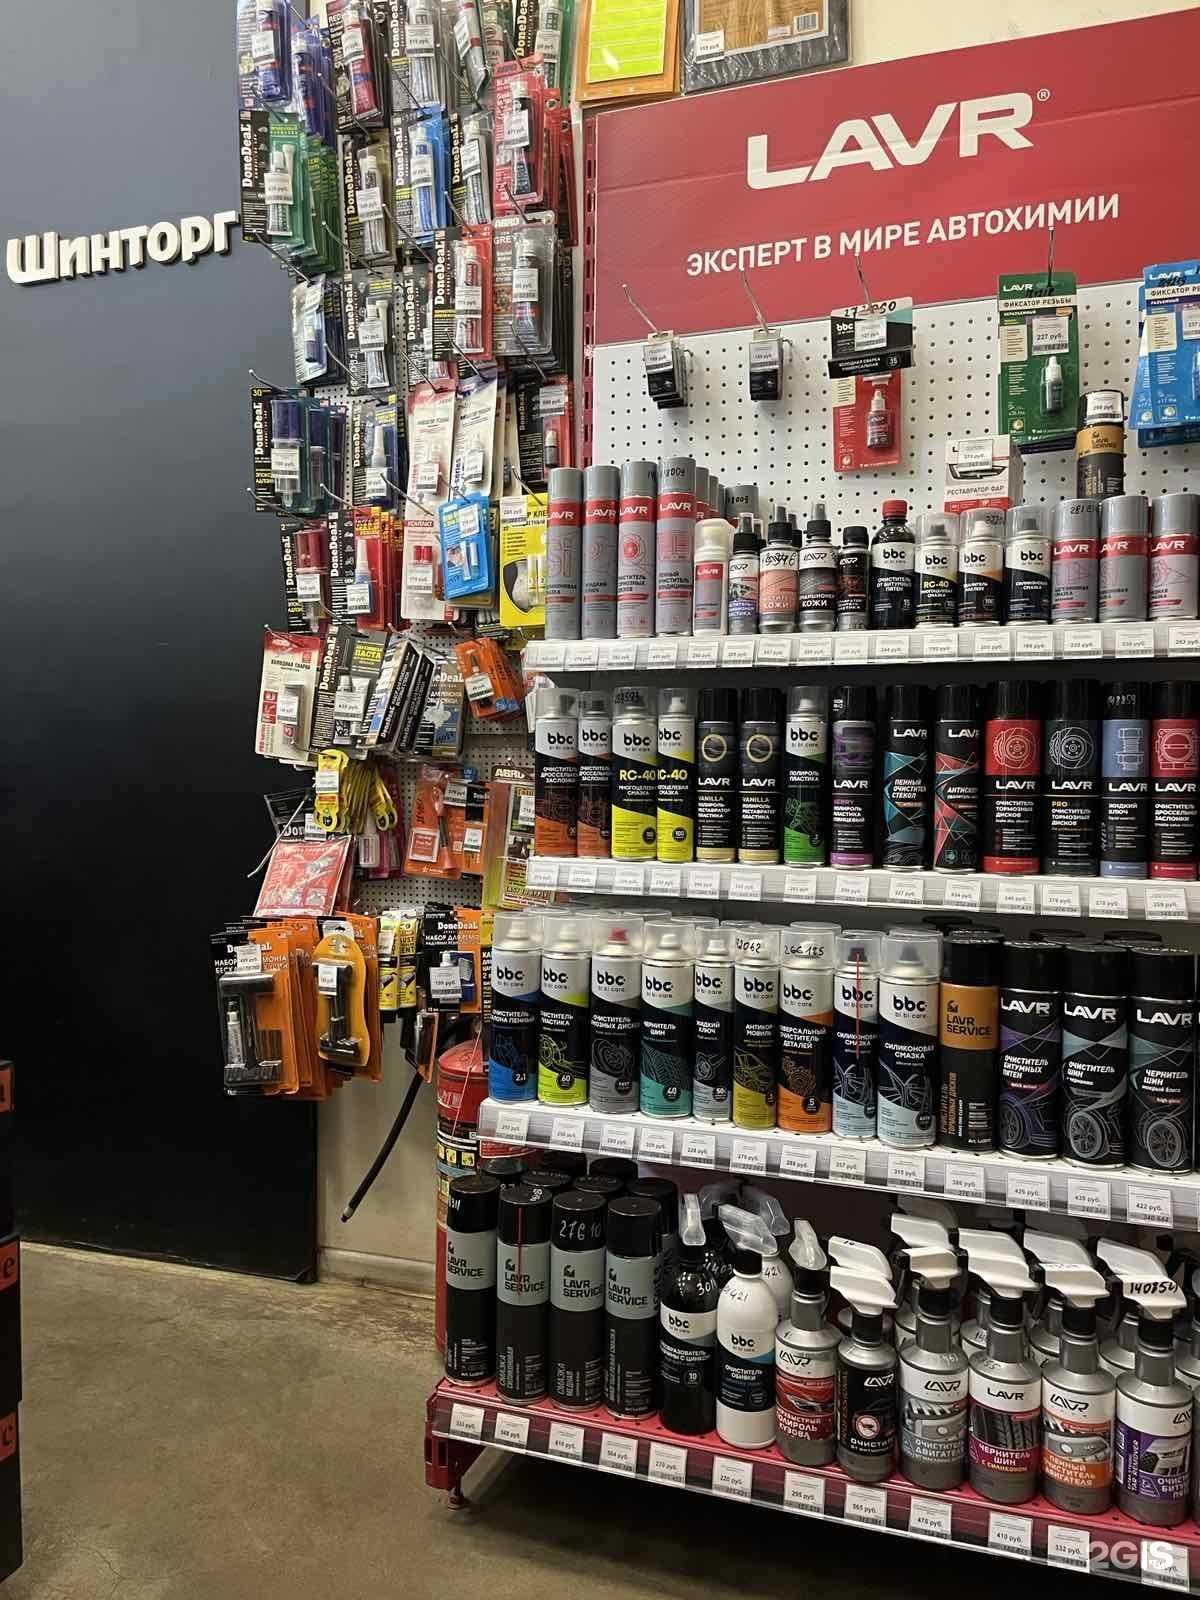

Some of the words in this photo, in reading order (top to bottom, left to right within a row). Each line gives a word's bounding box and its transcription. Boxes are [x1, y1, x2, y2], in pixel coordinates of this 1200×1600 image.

[747, 92, 1033, 190] LAVR
[687, 238, 806, 277] ЭКСПЕРТ
[814, 233, 832, 258] В
[839, 221, 920, 256] МИРЕ
[927, 194, 1120, 241] АВТОХИМИИ
[1150, 271, 1182, 280] LAVR
[1002, 284, 1033, 292] LAVR
[1150, 287, 1190, 296] ФИКСАТОР
[1003, 300, 1041, 308] ФИКСАТОР
[1042, 298, 1072, 306] РЕЗЬБЫ
[660, 502, 691, 511] LAVR
[586, 508, 616, 517] LAVR
[882, 548, 905, 558] bbc
[1054, 543, 1089, 554] LAVR
[925, 554, 947, 565] bbc
[963, 553, 985, 564] bbc
[1020, 551, 1043, 561] bbc
[802, 599, 828, 607] КОЖИ
[582, 729, 608, 741] bbc
[790, 728, 818, 741] bbc
[893, 729, 927, 737] LAVR
[548, 733, 573, 745] bbc
[624, 733, 650, 746] bbc
[619, 769, 655, 781] RC-40
[698, 777, 731, 786] LAVR
[742, 778, 776, 787] LAVR
[833, 780, 869, 788] LAVR
[996, 780, 1036, 790] LAVR
[1051, 781, 1092, 790] LAVR
[1108, 782, 1148, 792] LAVR
[1155, 783, 1197, 792] LAVR
[496, 966, 524, 981] bbc
[543, 967, 568, 983] bbc
[596, 970, 625, 986] bbc
[645, 976, 674, 992] bbc
[695, 973, 721, 988] bbc
[744, 977, 774, 993] bbc
[783, 984, 813, 1000] bbc
[841, 985, 874, 1001] bbc
[893, 994, 927, 1012] bbc
[1000, 997, 1050, 1014] LAVR
[1064, 1001, 1117, 1020] LAVR
[946, 1014, 976, 1026] LAVR
[1136, 1008, 1192, 1026] LAVR
[946, 1024, 993, 1036] SERVICE
[894, 1051, 925, 1060] СМАЗКА
[1004, 1055, 1049, 1066] ОЧИСТИТЕЛЬ
[1003, 1062, 1043, 1074] БИТУМНЫХ
[1068, 1061, 1115, 1073] ОЧИСТИТЕЛЬ
[561, 1074, 571, 1082] 60
[1067, 1069, 1084, 1078] ШИН
[1143, 1077, 1164, 1086] ШИН
[808, 1097, 815, 1106] 5
[504, 1272, 531, 1283] LAVR
[504, 1281, 545, 1292] SERVICE
[563, 1279, 591, 1289] LAVR
[563, 1287, 603, 1297] SERVICE
[608, 1284, 631, 1296] LAVR
[608, 1294, 649, 1306] SERVICE
[669, 1314, 690, 1329] bbc
[731, 1334, 755, 1348] bbc
[864, 1373, 895, 1388] LAVR
[924, 1380, 961, 1392] LAVR
[987, 1387, 1024, 1400] LAVR
[978, 1443, 1031, 1459] ЧЕРНИТЕЛЬ
[994, 1456, 1016, 1466] ШИН
